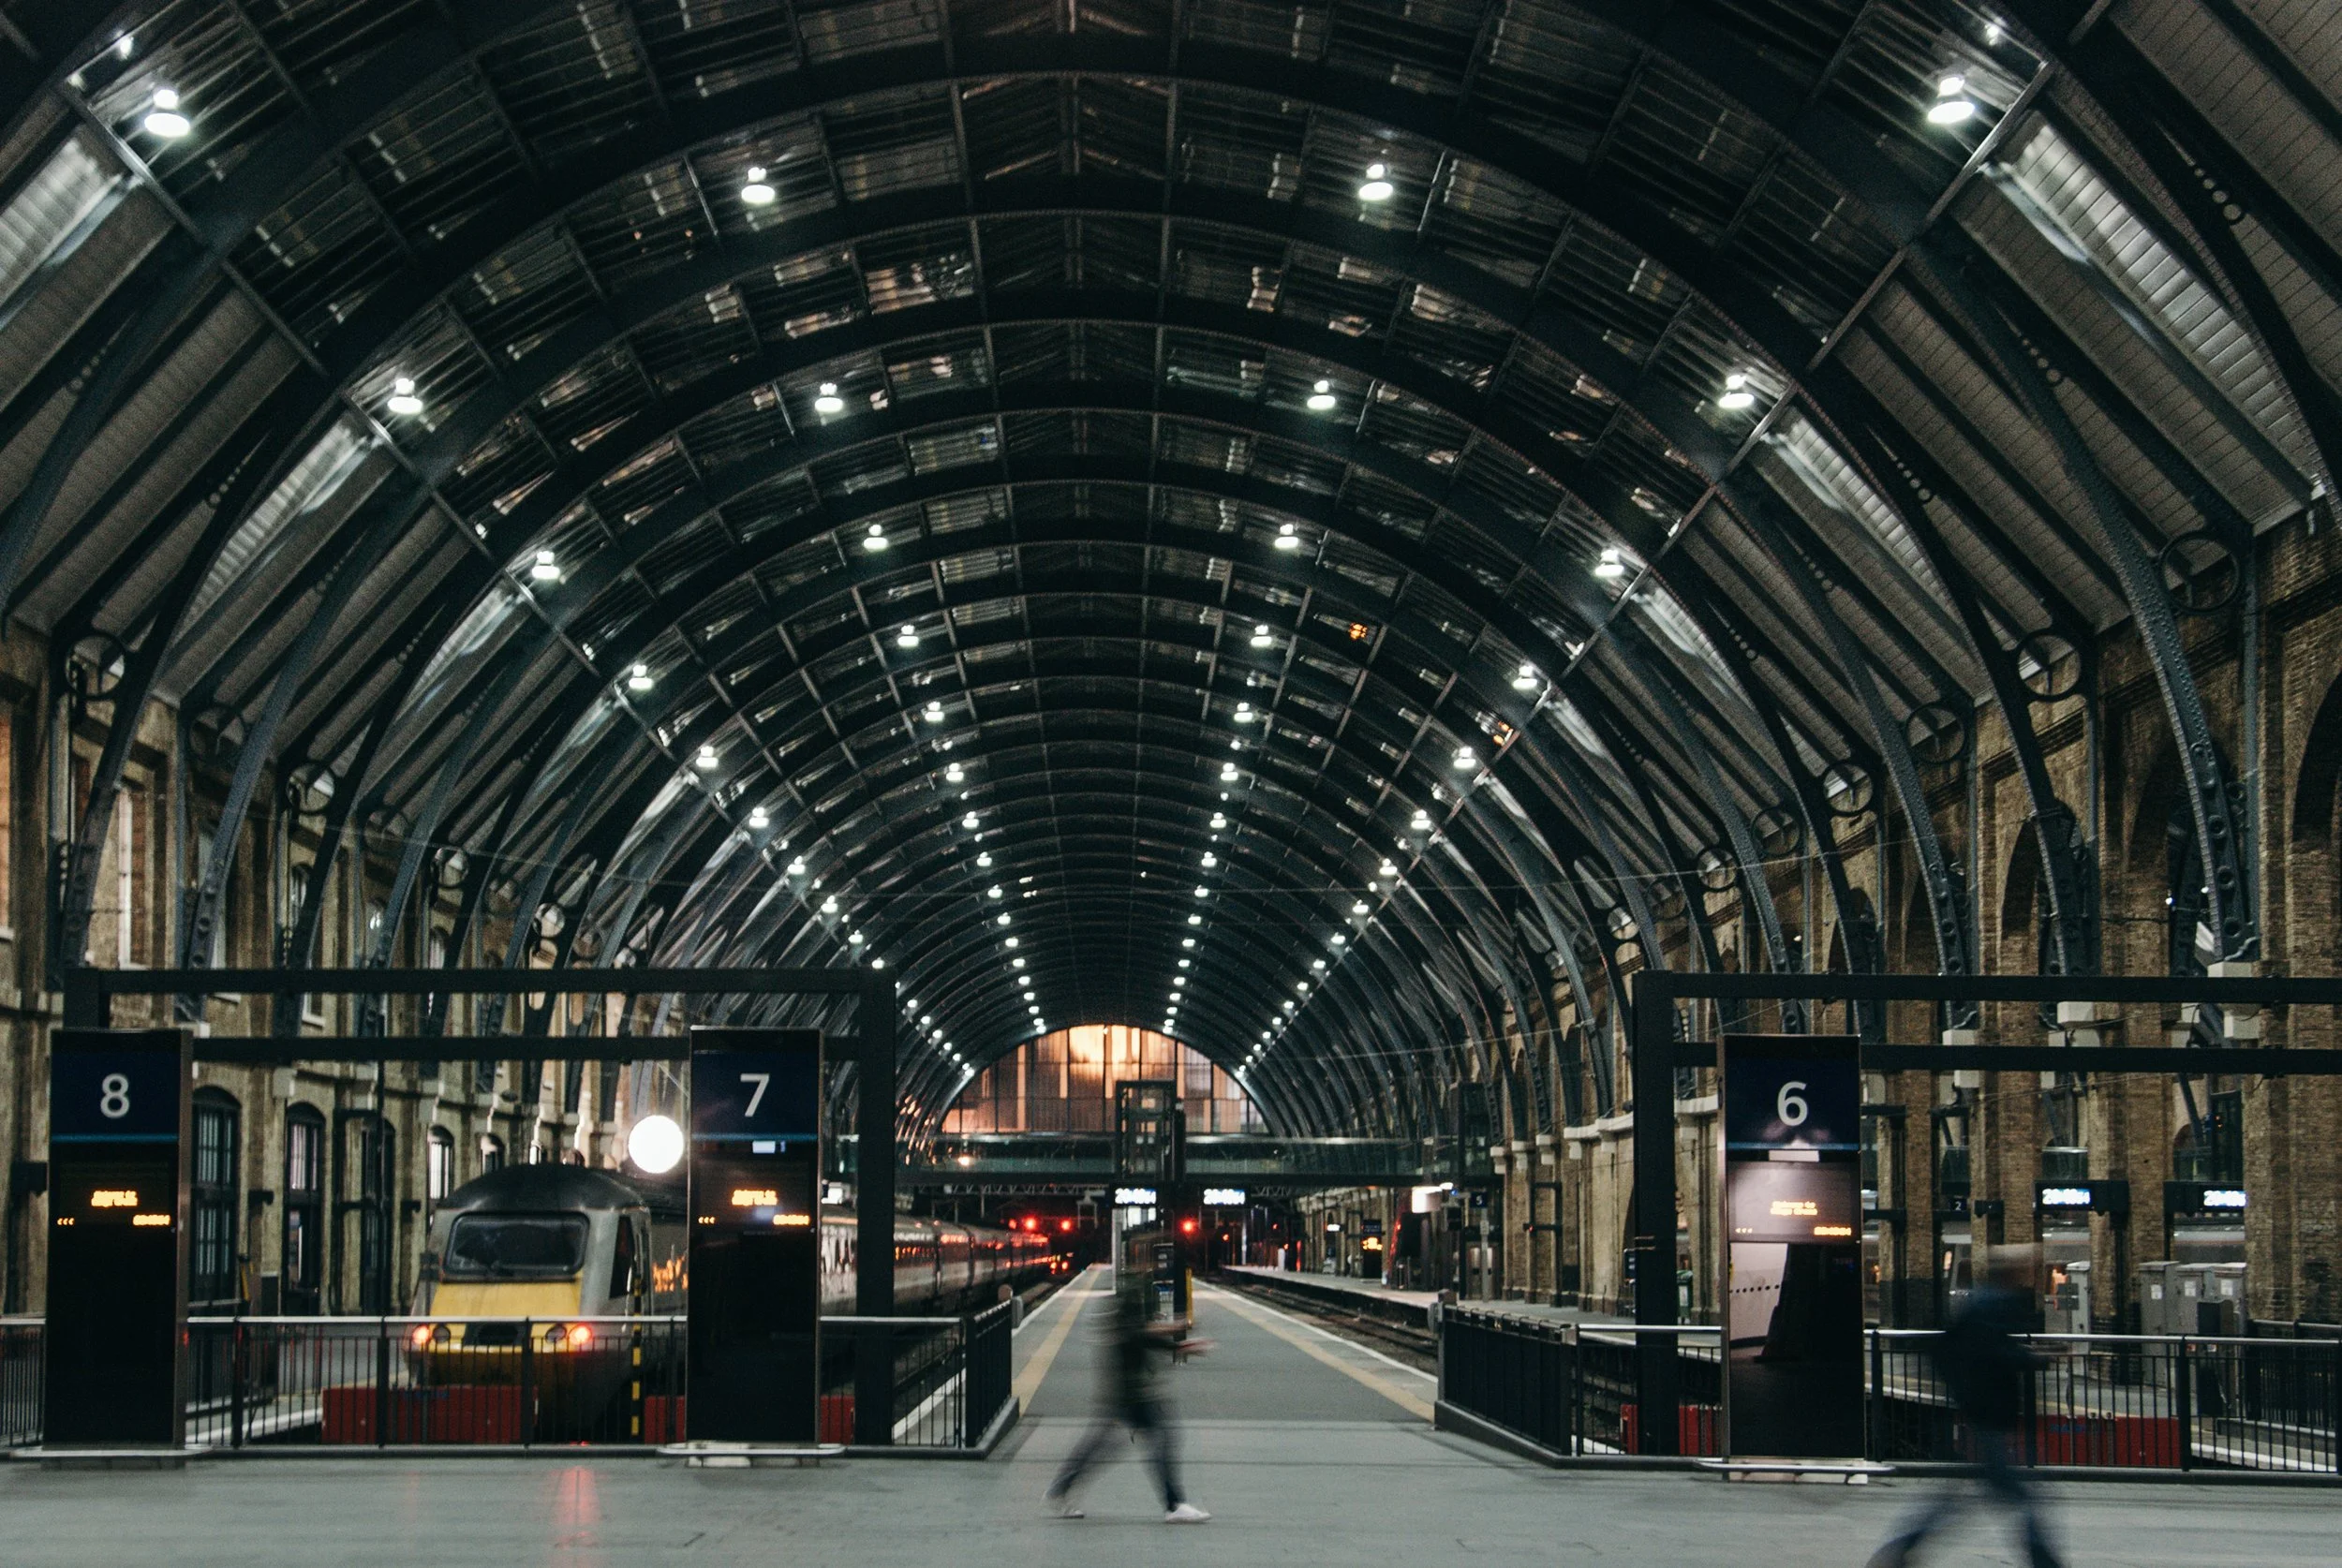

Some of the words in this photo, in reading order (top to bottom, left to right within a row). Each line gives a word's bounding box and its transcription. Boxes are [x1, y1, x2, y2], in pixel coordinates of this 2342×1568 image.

[100, 1073, 130, 1118] 8
[740, 1073, 770, 1117] 7
[1777, 1081, 1808, 1127] 6
[1954, 1201, 1962, 1211] 2
